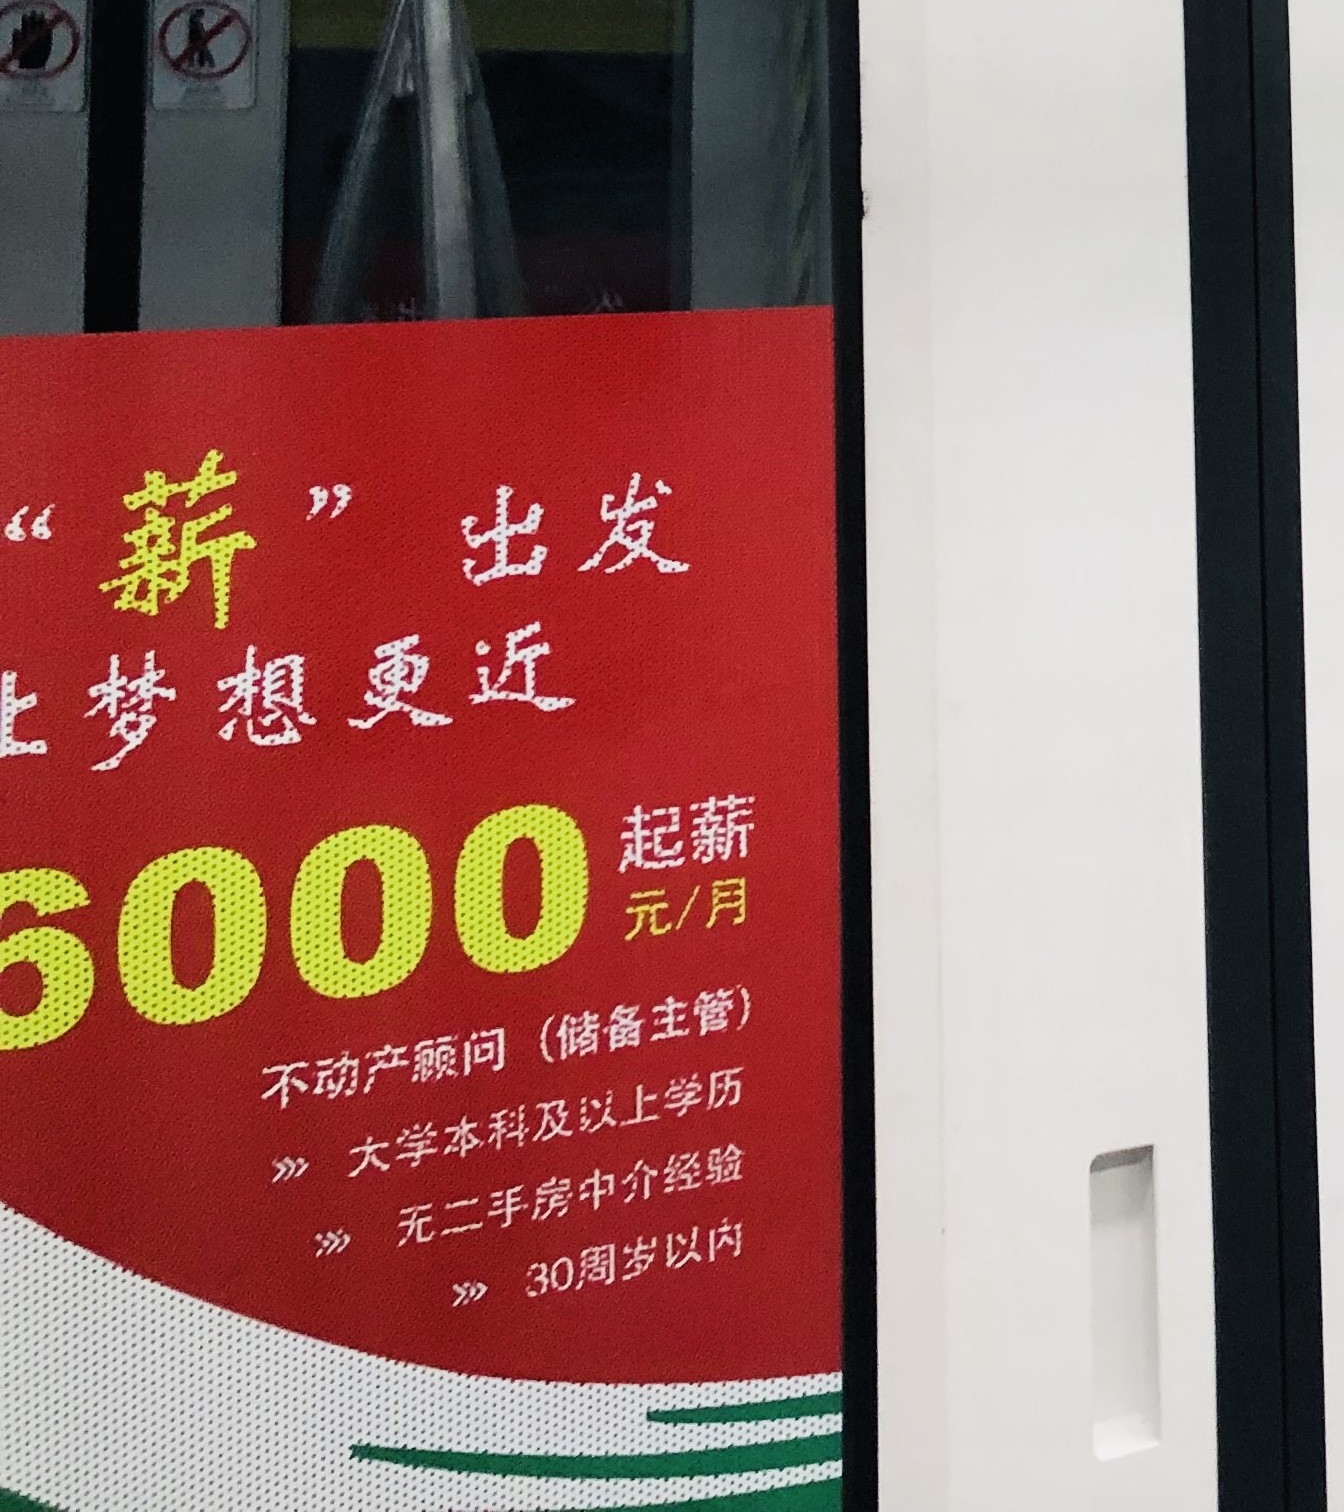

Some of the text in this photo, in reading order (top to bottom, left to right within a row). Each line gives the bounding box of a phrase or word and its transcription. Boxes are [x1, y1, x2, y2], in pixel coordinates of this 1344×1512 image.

[619, 795, 756, 873] 起薪
[0, 804, 590, 1051] 6000
[625, 877, 749, 942] 元/月
[348, 1067, 745, 1179] 大学本科及以上学历
[397, 1144, 745, 1248] 无二手房中介经验
[524, 1218, 745, 1299] 30周岁以内
